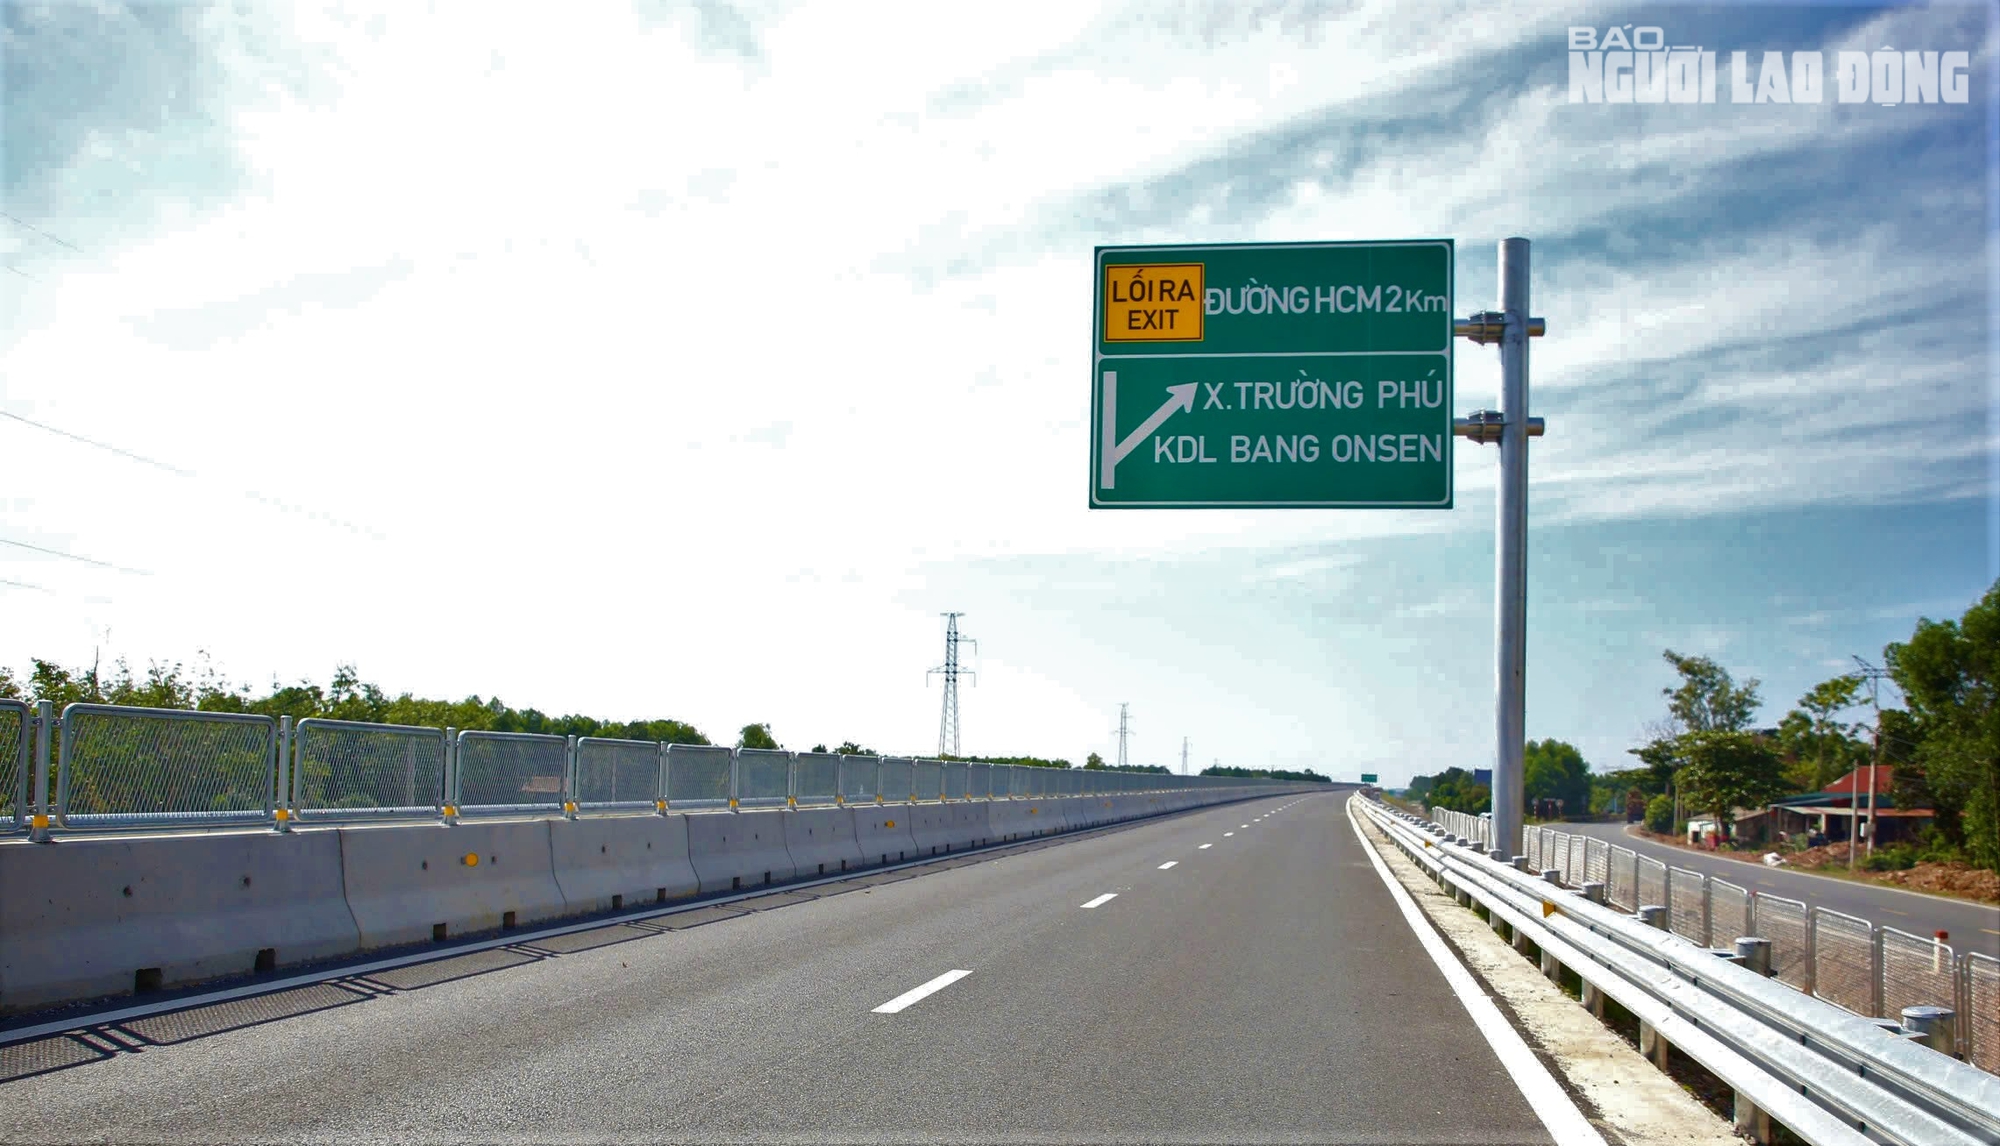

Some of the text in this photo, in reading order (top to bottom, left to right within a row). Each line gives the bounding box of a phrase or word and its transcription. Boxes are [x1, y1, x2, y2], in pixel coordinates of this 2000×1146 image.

[1112, 268, 1195, 303] LỐI RA
[1203, 277, 1310, 316] ĐƯỜNG
[1315, 285, 1382, 313] HCM
[1128, 309, 1179, 330] EXIT
[1378, 369, 1443, 409] PHÚ
[1154, 434, 1442, 464] KDL BANG ONSEN
